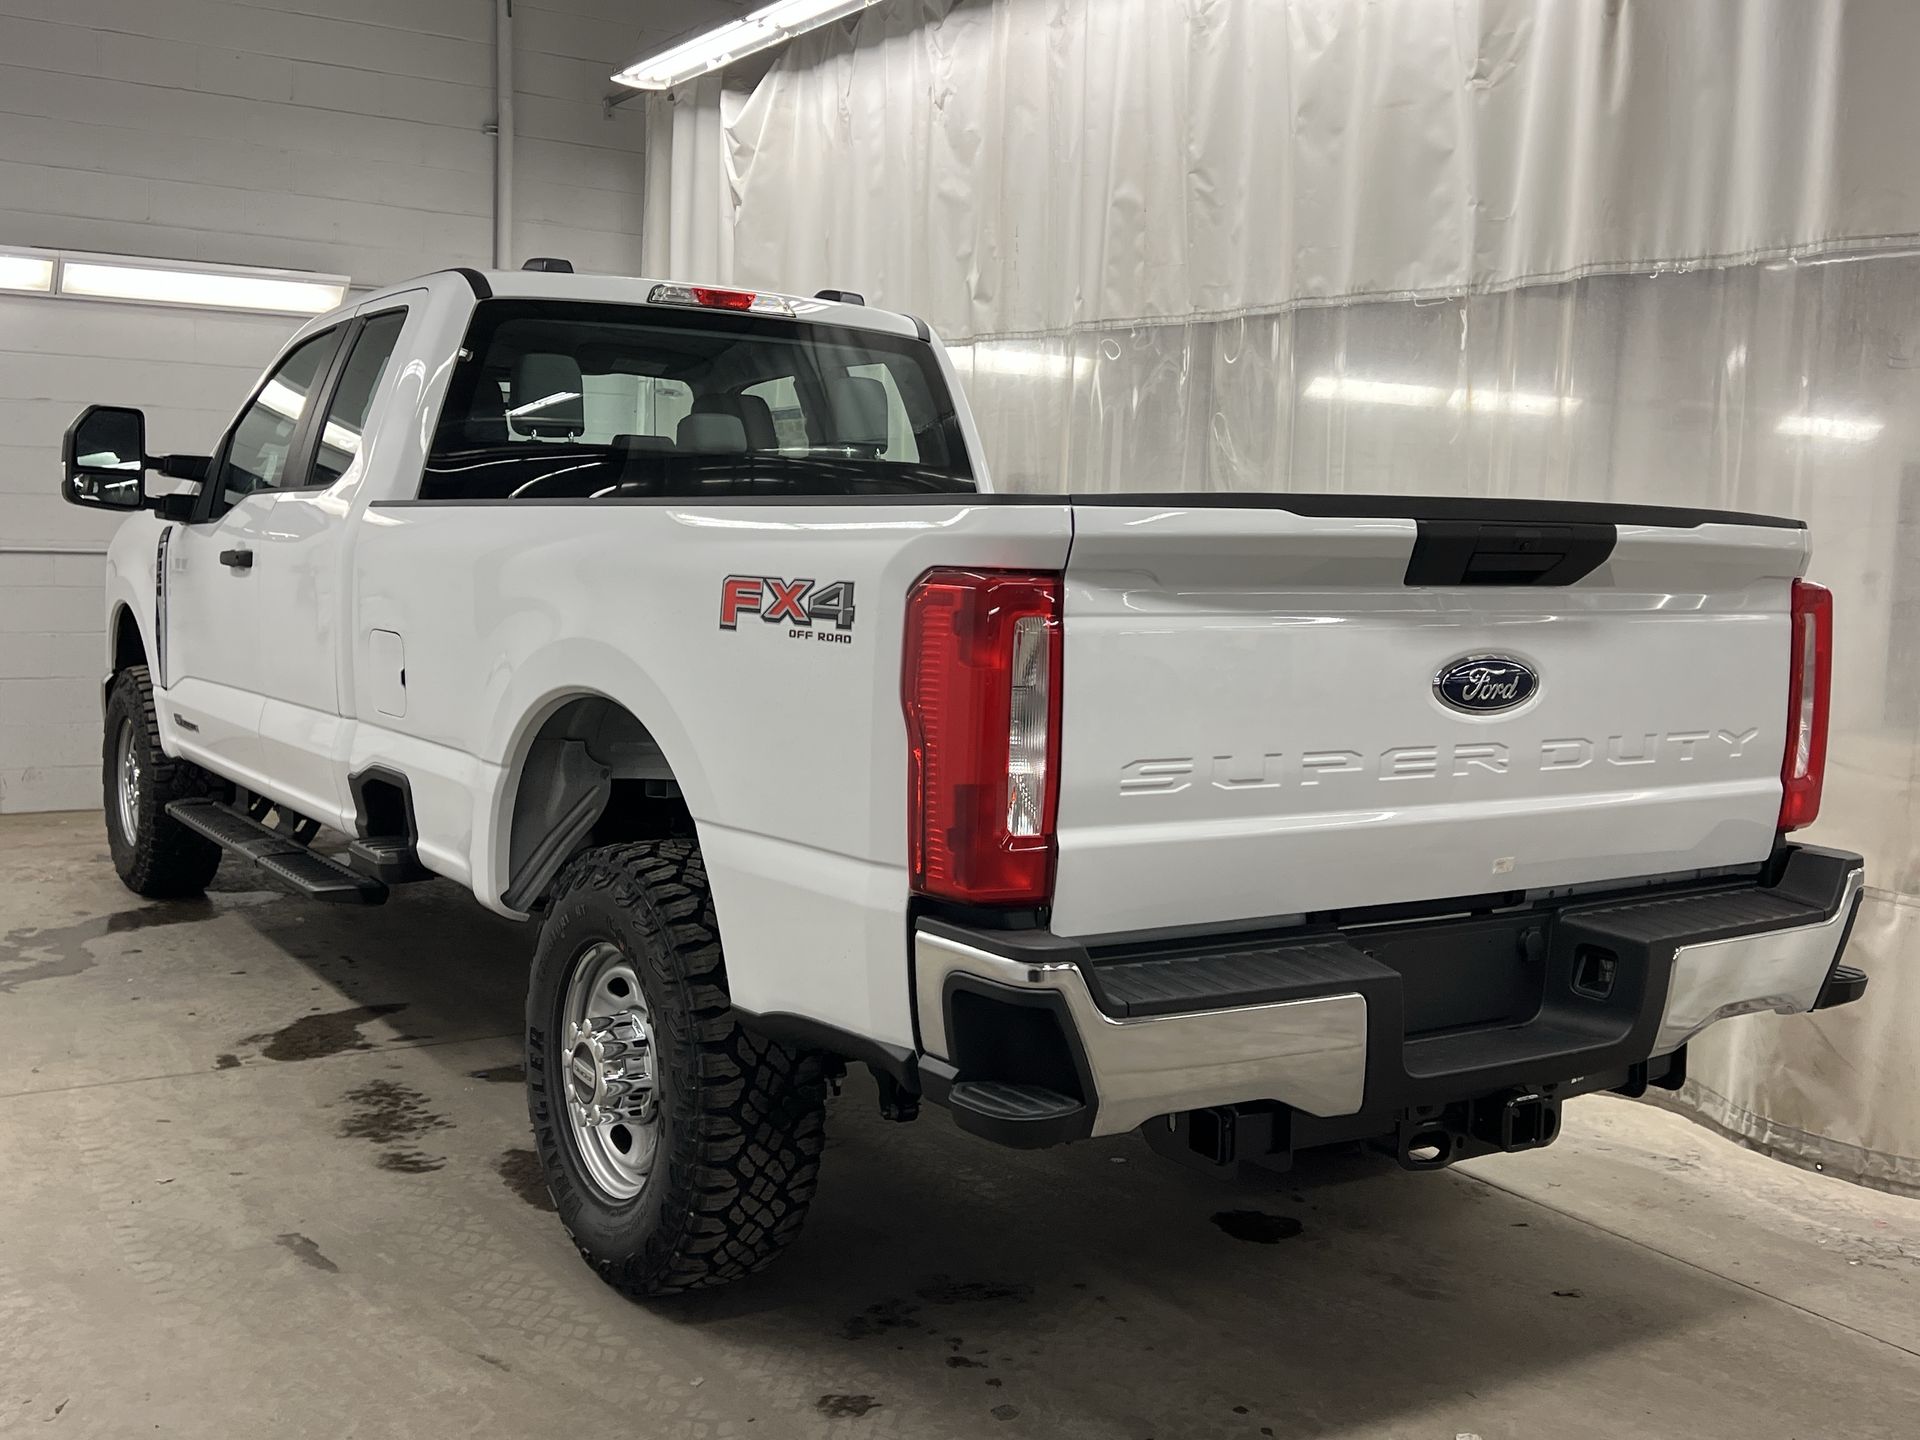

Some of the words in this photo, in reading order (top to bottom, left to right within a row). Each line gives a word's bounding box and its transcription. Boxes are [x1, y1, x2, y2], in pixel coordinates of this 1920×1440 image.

[719, 574, 855, 631] FX4
[789, 629, 813, 640] OFF
[817, 632, 852, 644] ROAD
[1462, 667, 1520, 701] Ford
[1119, 742, 1510, 796] SUPER
[1540, 727, 1759, 771] DUTY
[529, 1024, 584, 1222] WRANGLER
